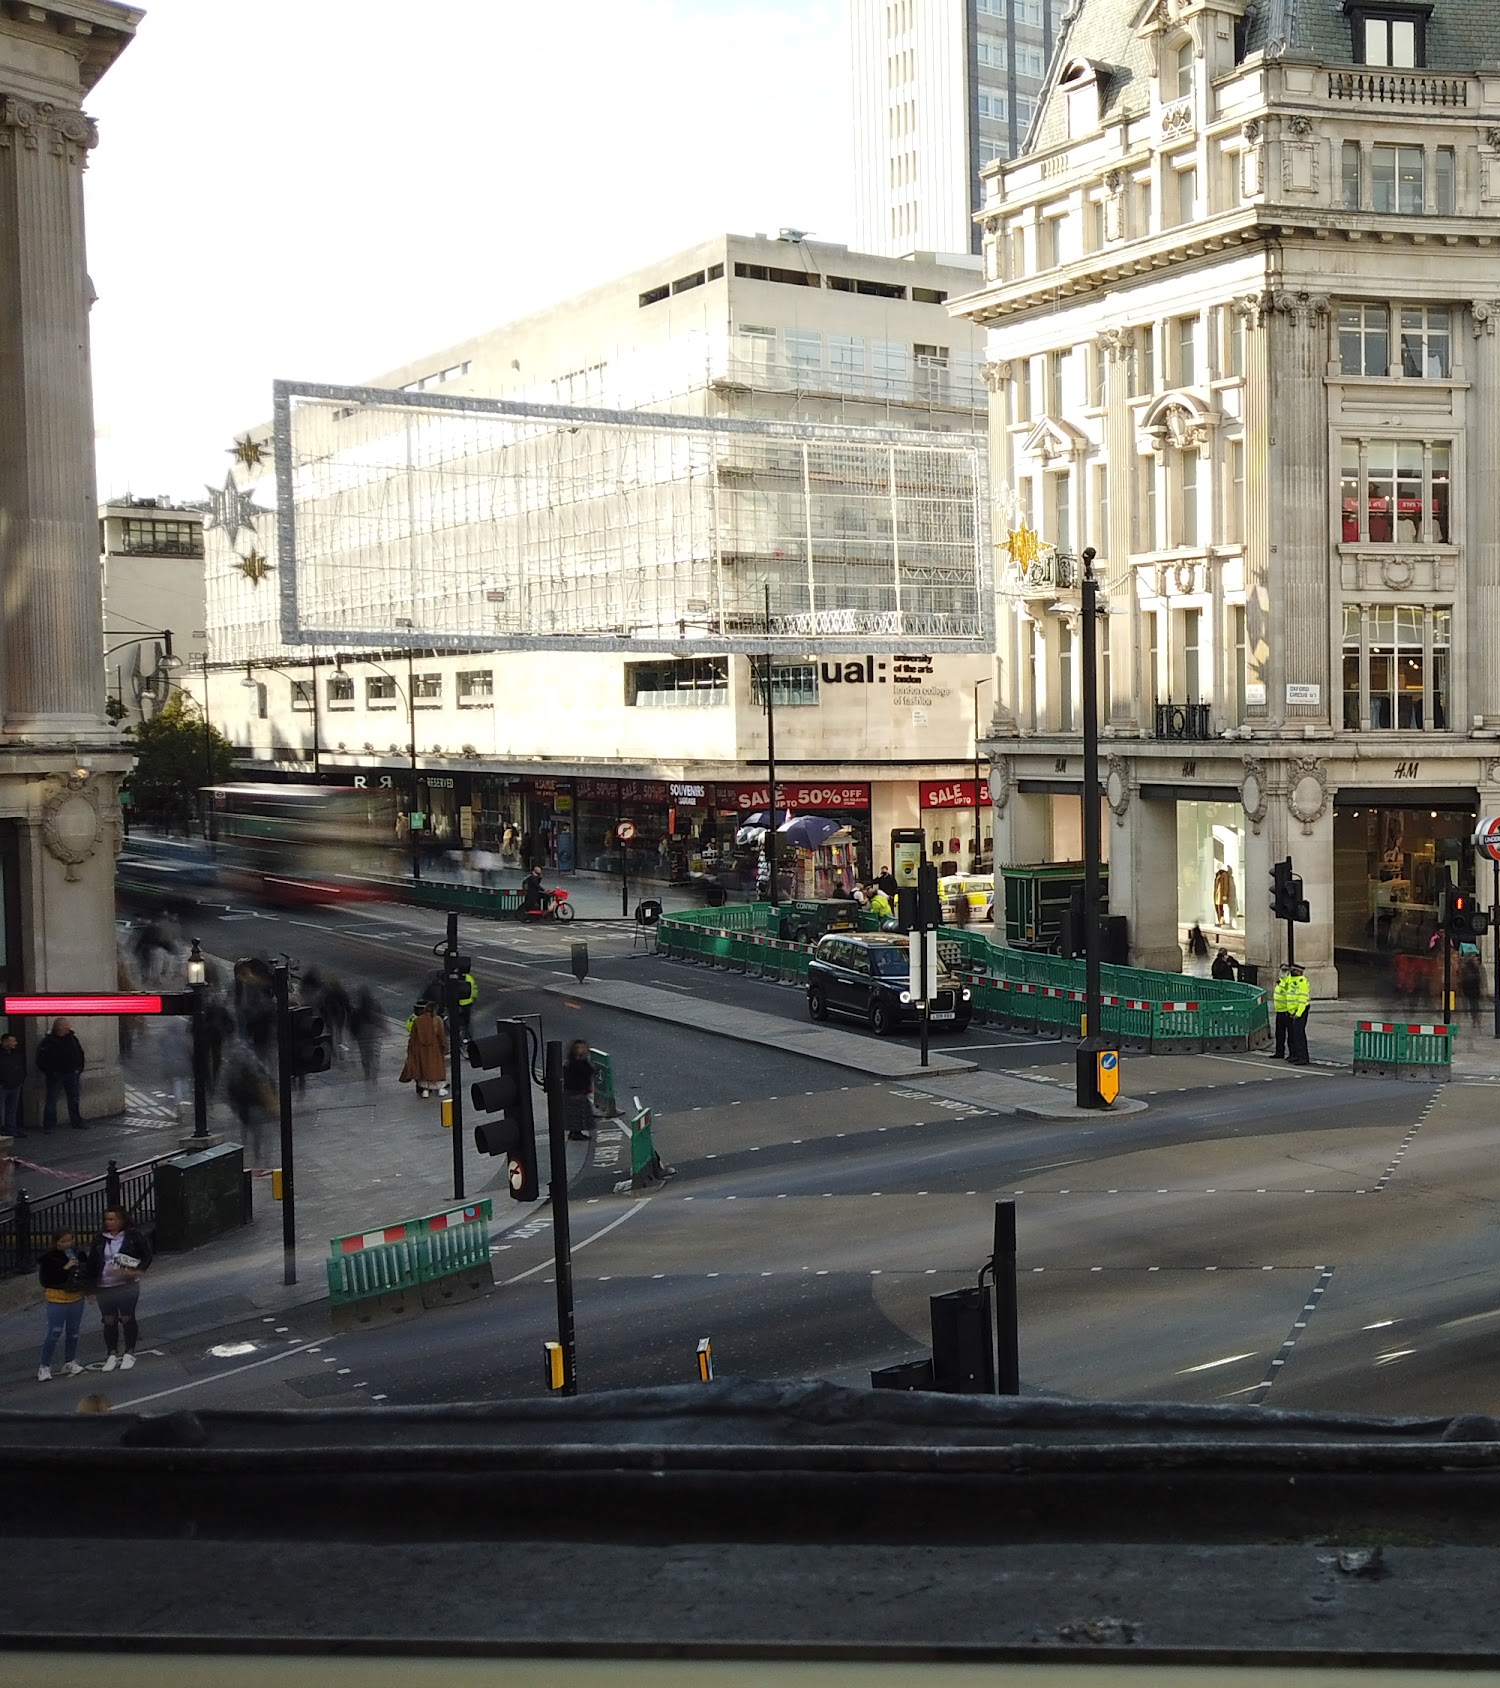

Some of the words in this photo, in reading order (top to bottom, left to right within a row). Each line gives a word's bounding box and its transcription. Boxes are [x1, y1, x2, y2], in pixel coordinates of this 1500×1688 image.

[821, 655, 887, 684] ual:
[893, 664, 902, 673] of
[903, 664, 917, 673] the
[917, 665, 934, 674] arts
[893, 674, 922, 684] london
[893, 685, 921, 696] london
[1393, 762, 1420, 779] H&M
[426, 776, 454, 789] RESERVED
[669, 783, 706, 798] SOUVENIRS
[797, 788, 842, 805] 50%
[841, 789, 862, 798] OFF
[928, 783, 962, 806] SALE
[795, 902, 819, 911] CONWAY
